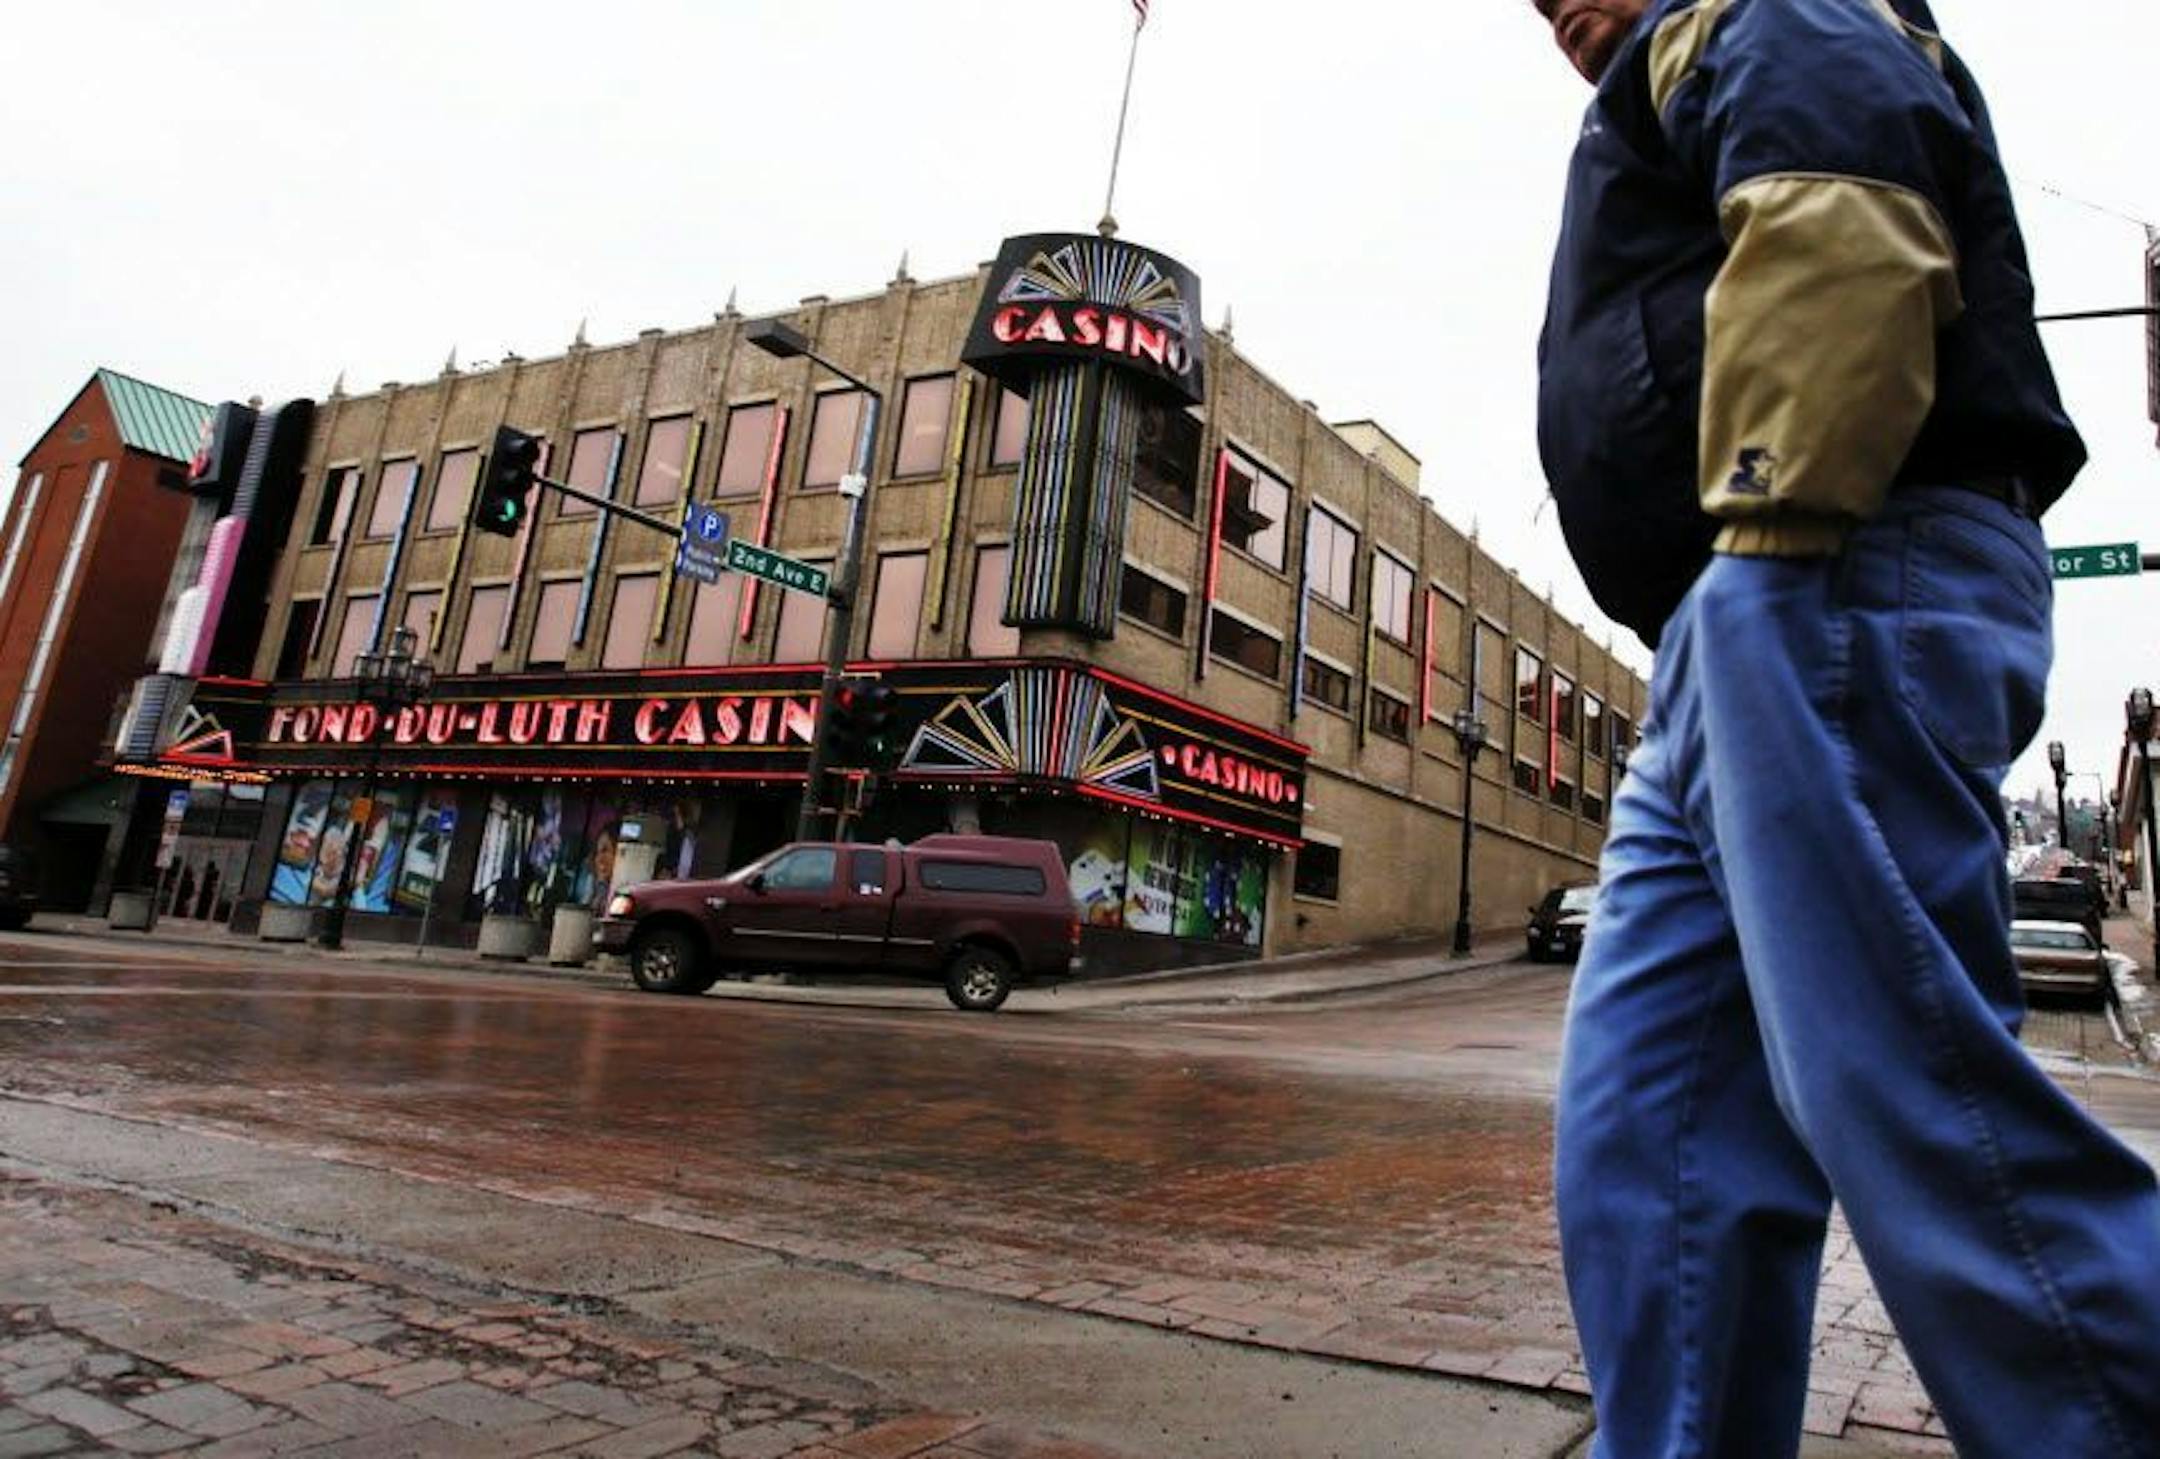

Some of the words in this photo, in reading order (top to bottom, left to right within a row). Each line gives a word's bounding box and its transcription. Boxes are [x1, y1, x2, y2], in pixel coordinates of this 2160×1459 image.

[993, 305, 1193, 377] CASINO
[734, 547, 767, 573] 2nd
[772, 560, 804, 584] Ave
[809, 572, 823, 592] E
[2100, 550, 2131, 570] St
[634, 697, 820, 745] CASIN
[1181, 743, 1284, 804] CASINO
